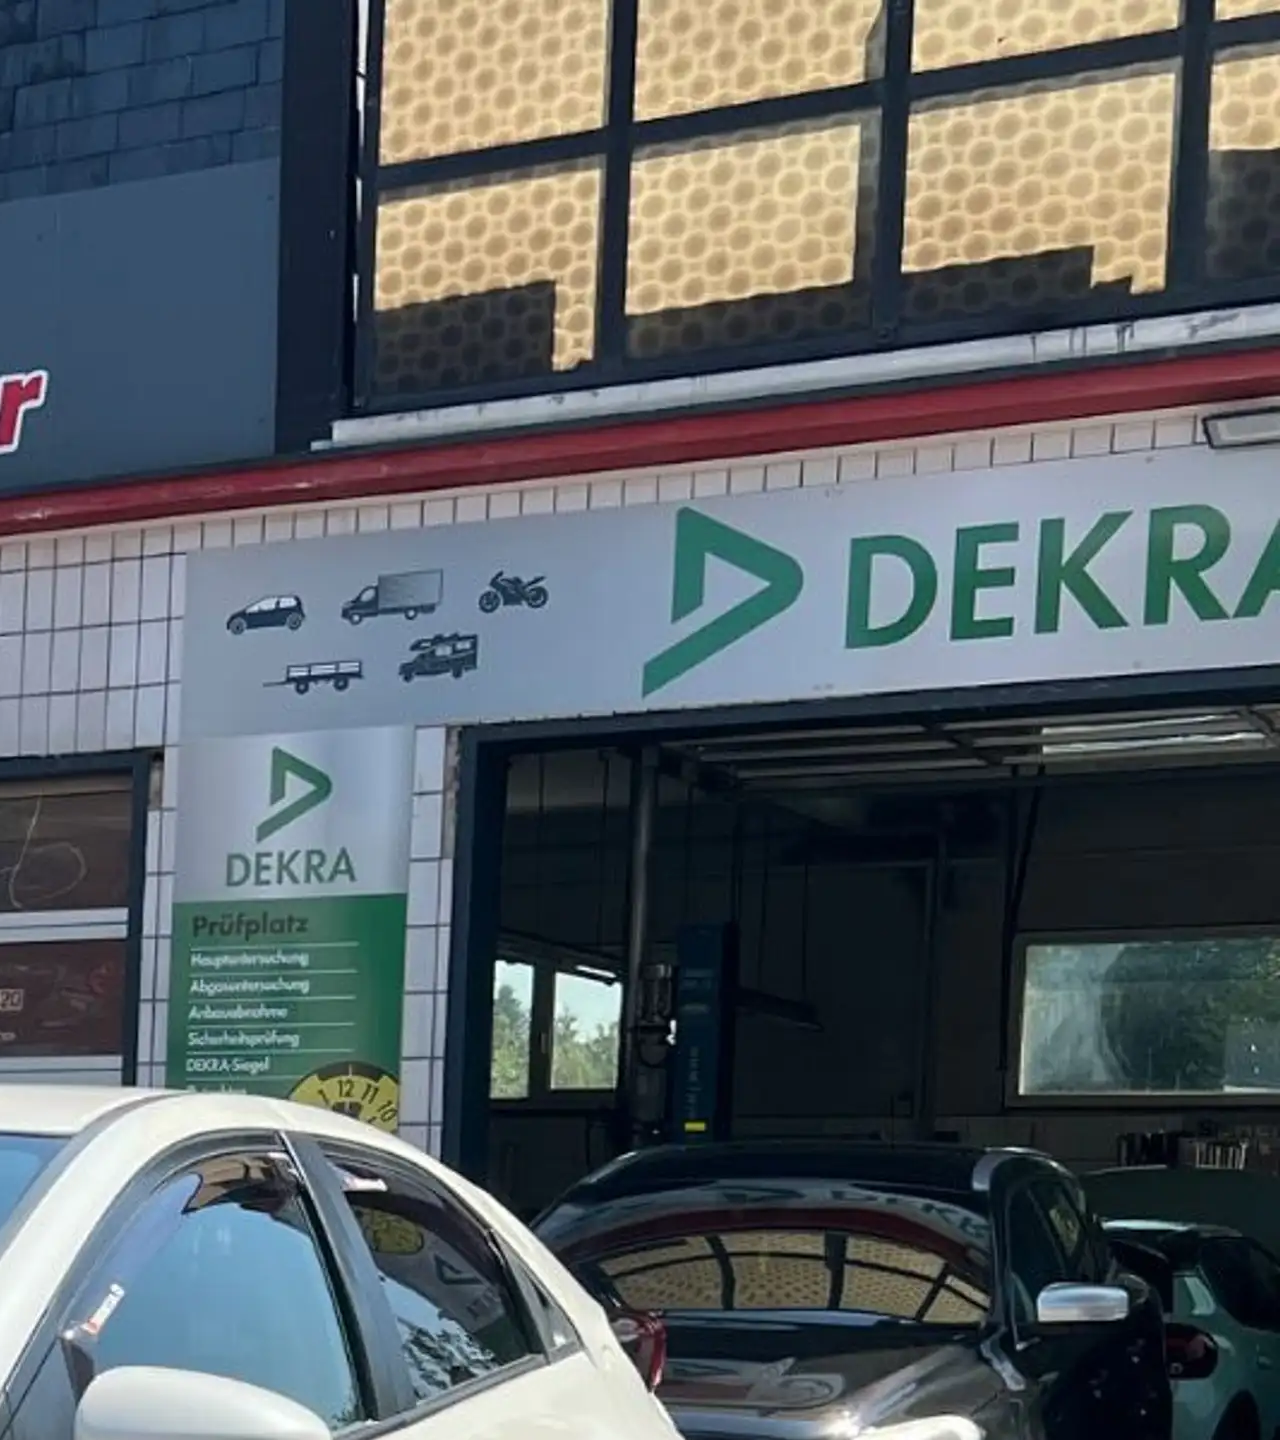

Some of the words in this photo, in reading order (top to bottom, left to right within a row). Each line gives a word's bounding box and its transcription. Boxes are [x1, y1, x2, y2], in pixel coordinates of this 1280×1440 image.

[225, 847, 357, 887] DEKRA
[193, 912, 309, 940] Prüfplatz
[190, 950, 310, 969] Hauptuntersuchung
[190, 978, 310, 997] Abgasuntersuchung
[188, 1004, 288, 1020] Anbauabnahme
[188, 1030, 300, 1049] Sicherheitsprüfung
[186, 1056, 270, 1075] DEKRA-Siegel
[338, 1079, 355, 1098] 12
